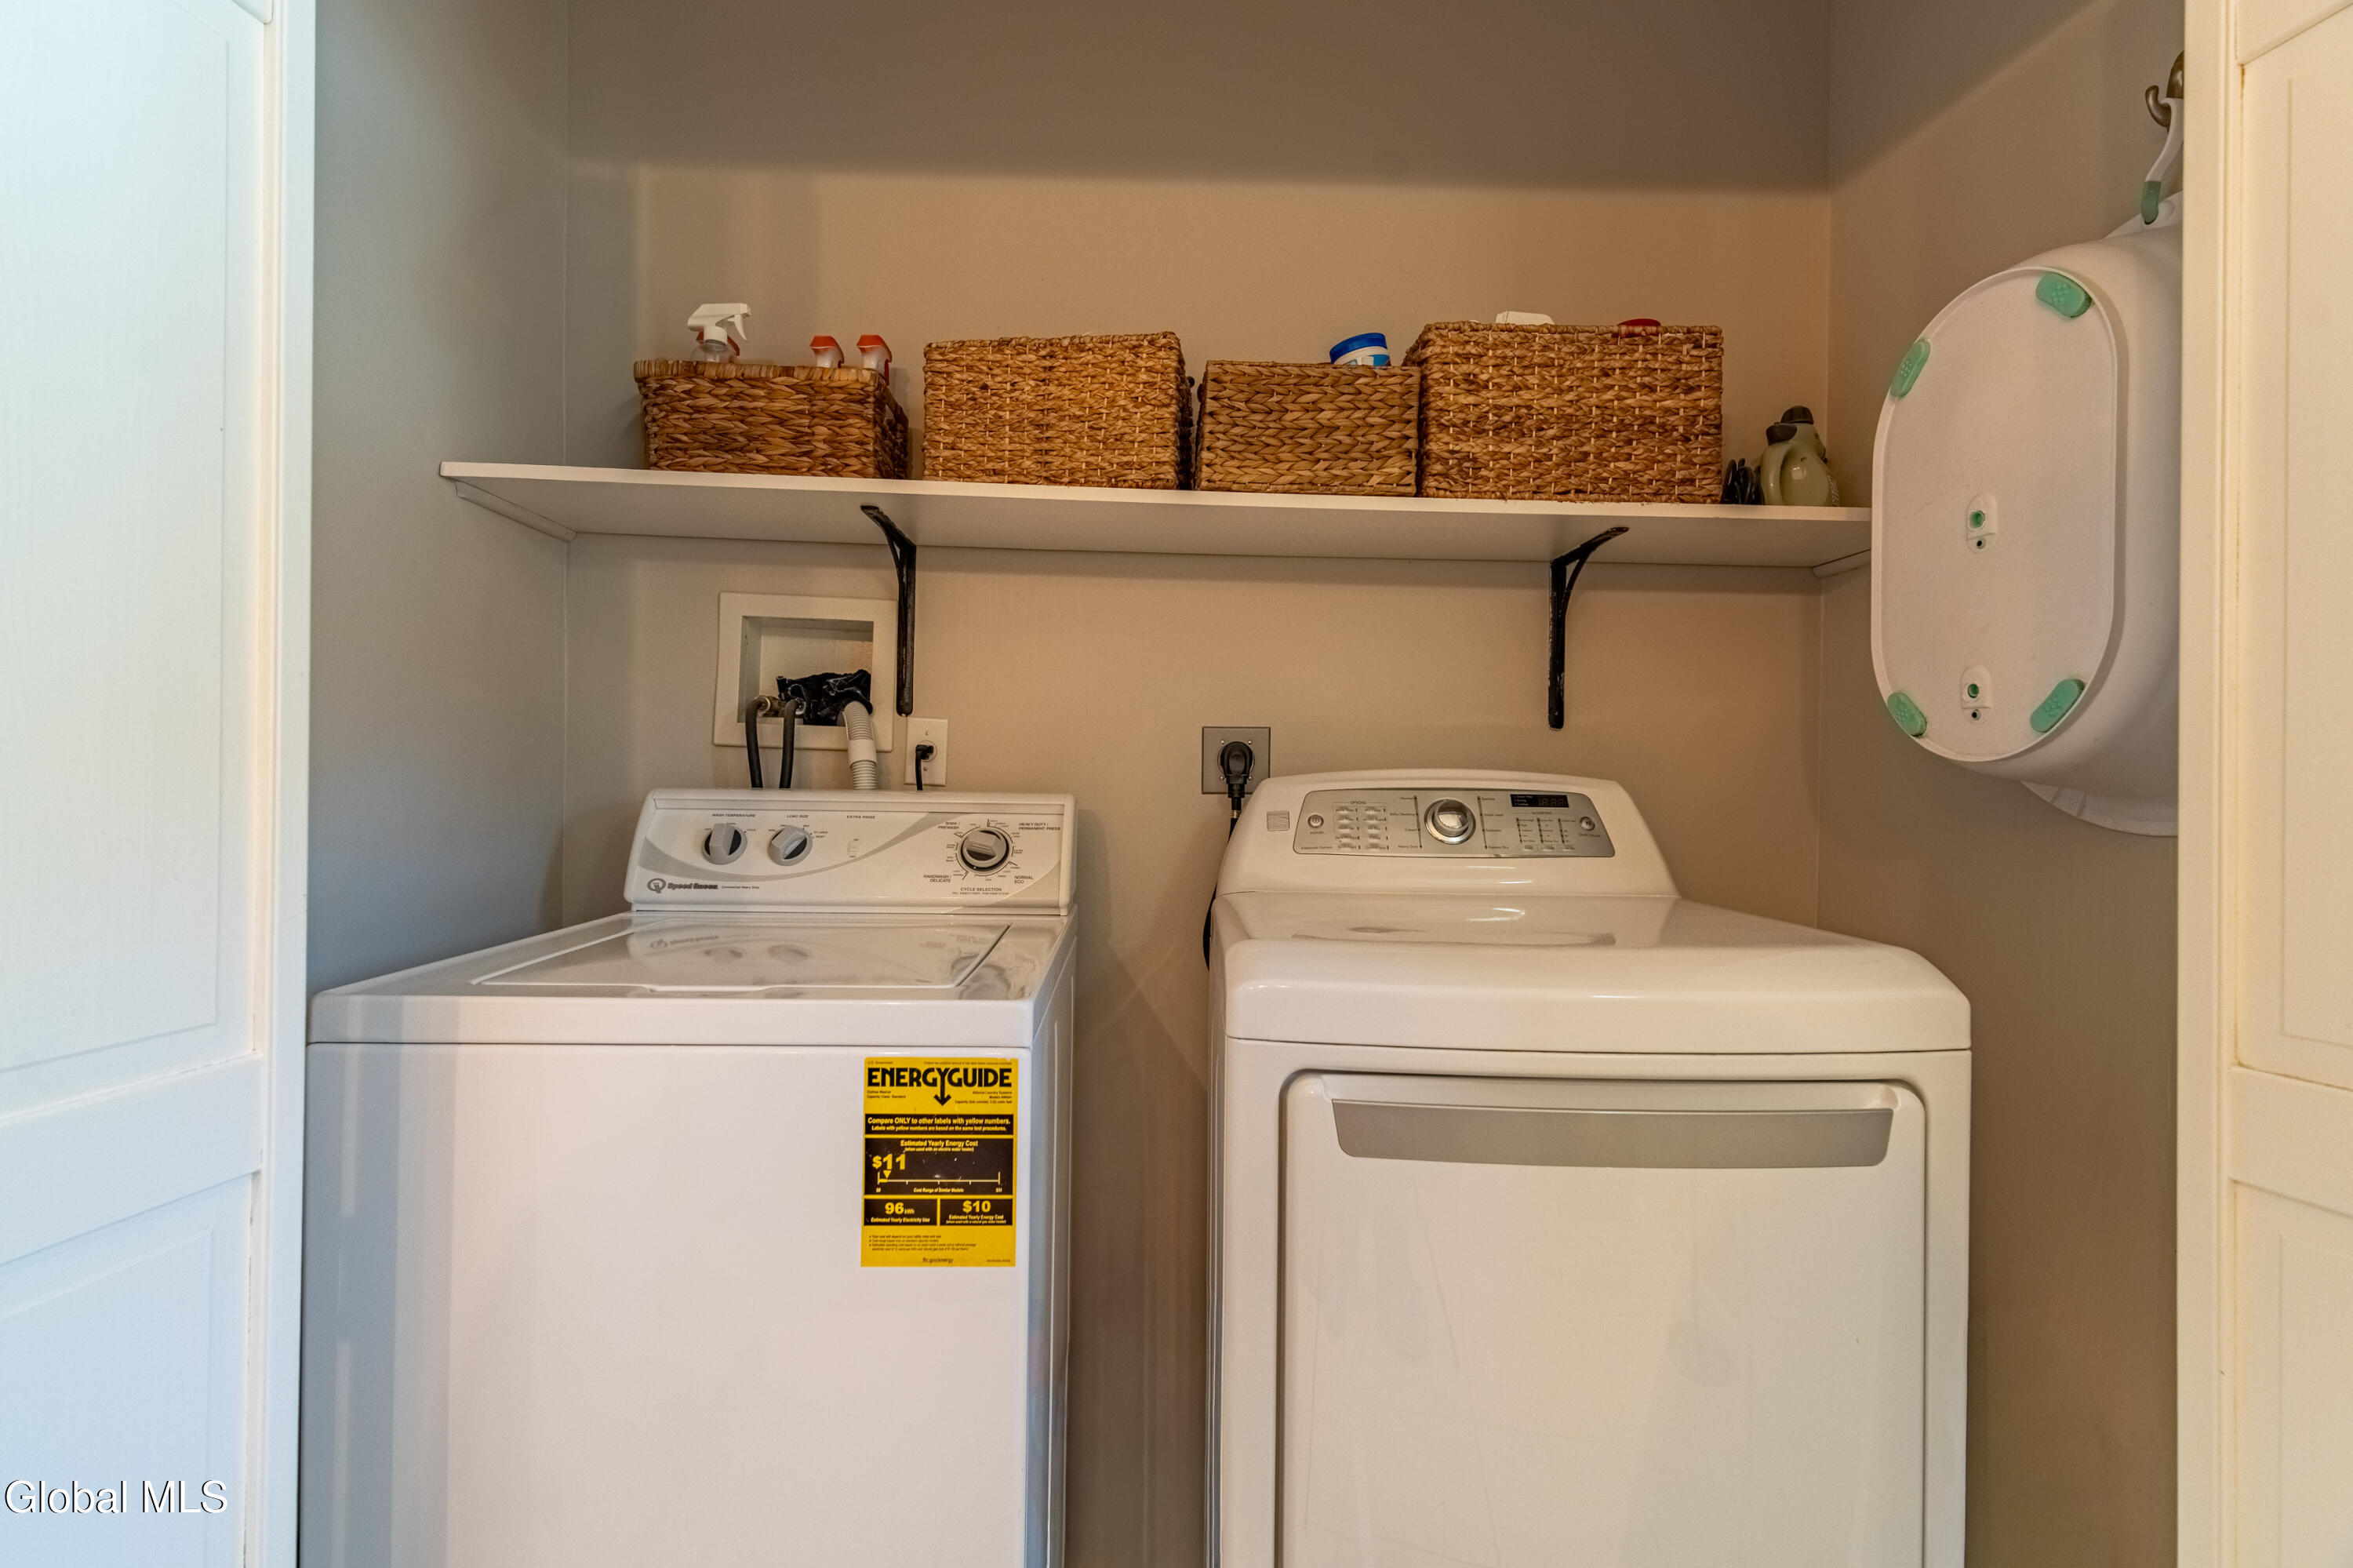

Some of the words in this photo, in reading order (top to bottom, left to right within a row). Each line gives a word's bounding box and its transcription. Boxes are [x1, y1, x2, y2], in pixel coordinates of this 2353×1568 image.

[867, 1068, 1012, 1089] ENERGYGUIDE
[867, 1117, 894, 1126] Compare
[873, 1154, 906, 1170] $11
[885, 1202, 904, 1215] 96
[962, 1200, 991, 1213] $10
